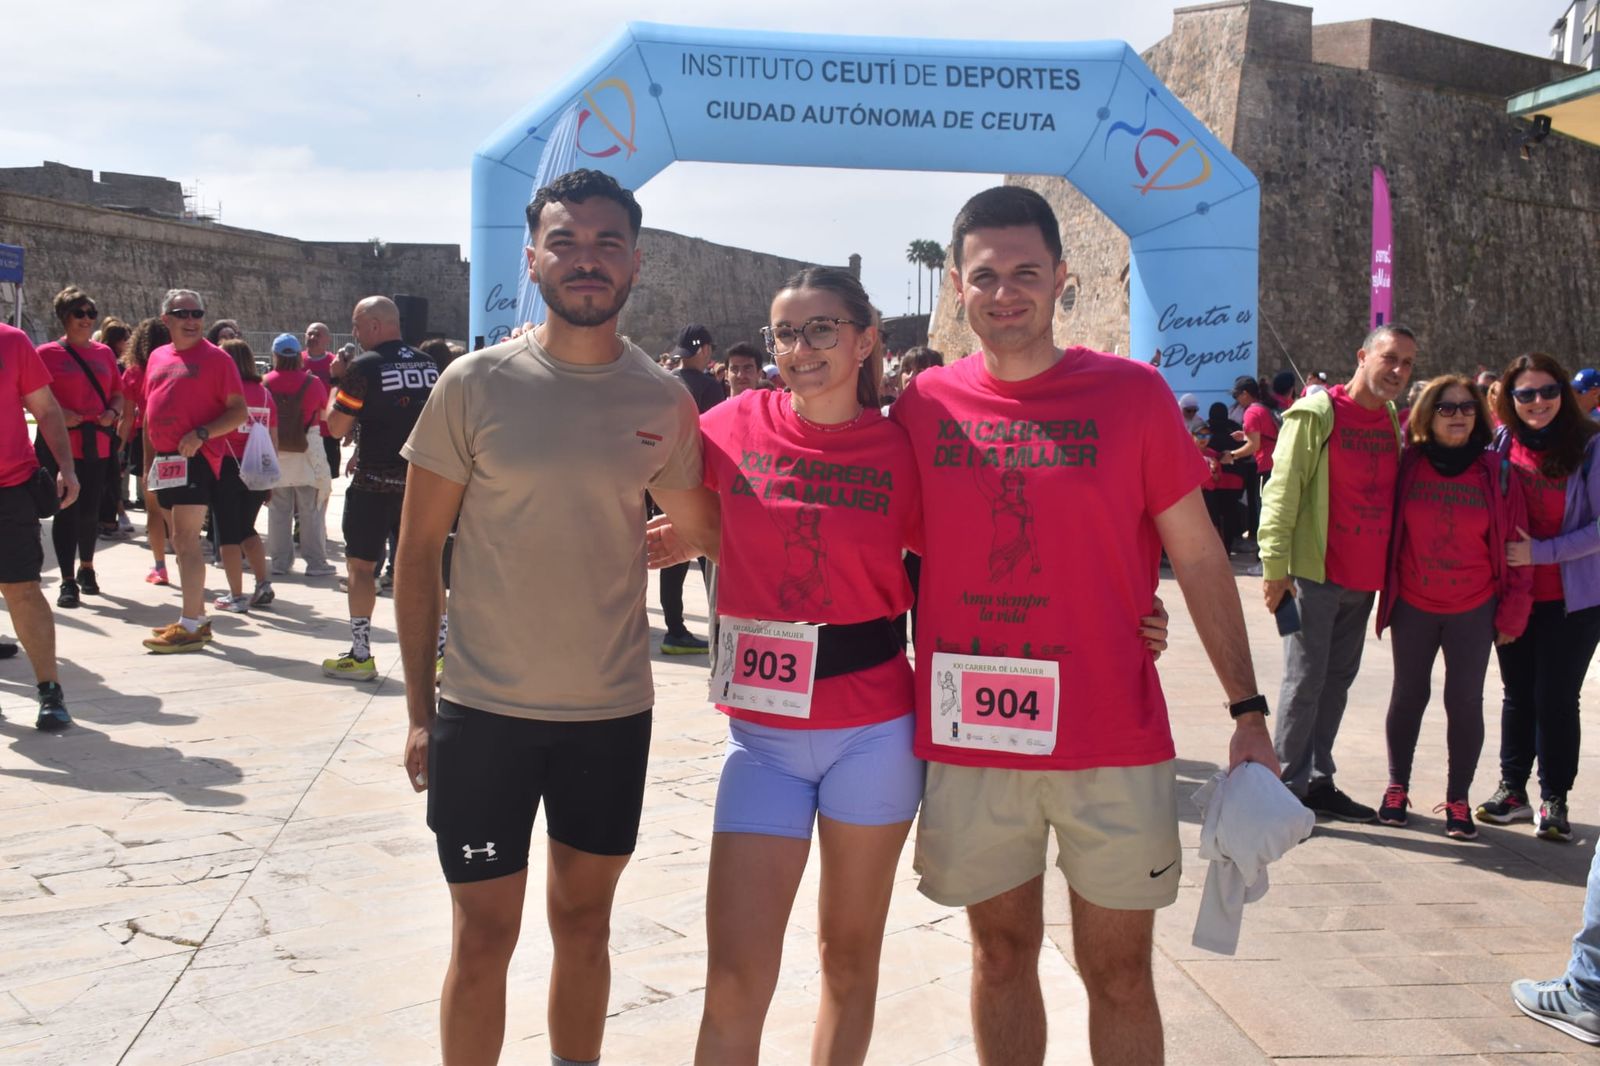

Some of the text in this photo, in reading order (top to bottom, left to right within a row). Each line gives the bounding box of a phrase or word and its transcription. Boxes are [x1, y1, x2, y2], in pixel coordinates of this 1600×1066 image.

[682, 53, 1081, 91] INSTITUTO CEUTÍ DE DEPORTES
[706, 100, 1056, 132] CIUDAD AUTÓNOMA DE CEUTA
[1158, 303, 1253, 332] Ceuta es
[1162, 341, 1252, 378] Deporte
[381, 369, 440, 391] 300
[937, 419, 1099, 442] XXI CARRERA
[162, 465, 182, 477] 277
[739, 450, 894, 491] XXI CARRERA
[933, 445, 963, 468] DE
[1003, 445, 1098, 469] MUJER
[731, 474, 762, 498] DE
[802, 483, 890, 516] MUJER
[743, 648, 797, 683] 903
[964, 663, 997, 673] CARRERA
[998, 665, 1008, 673] DE
[1009, 666, 1019, 674] LA
[1020, 667, 1044, 675] MUJER
[975, 687, 1040, 721] 904
